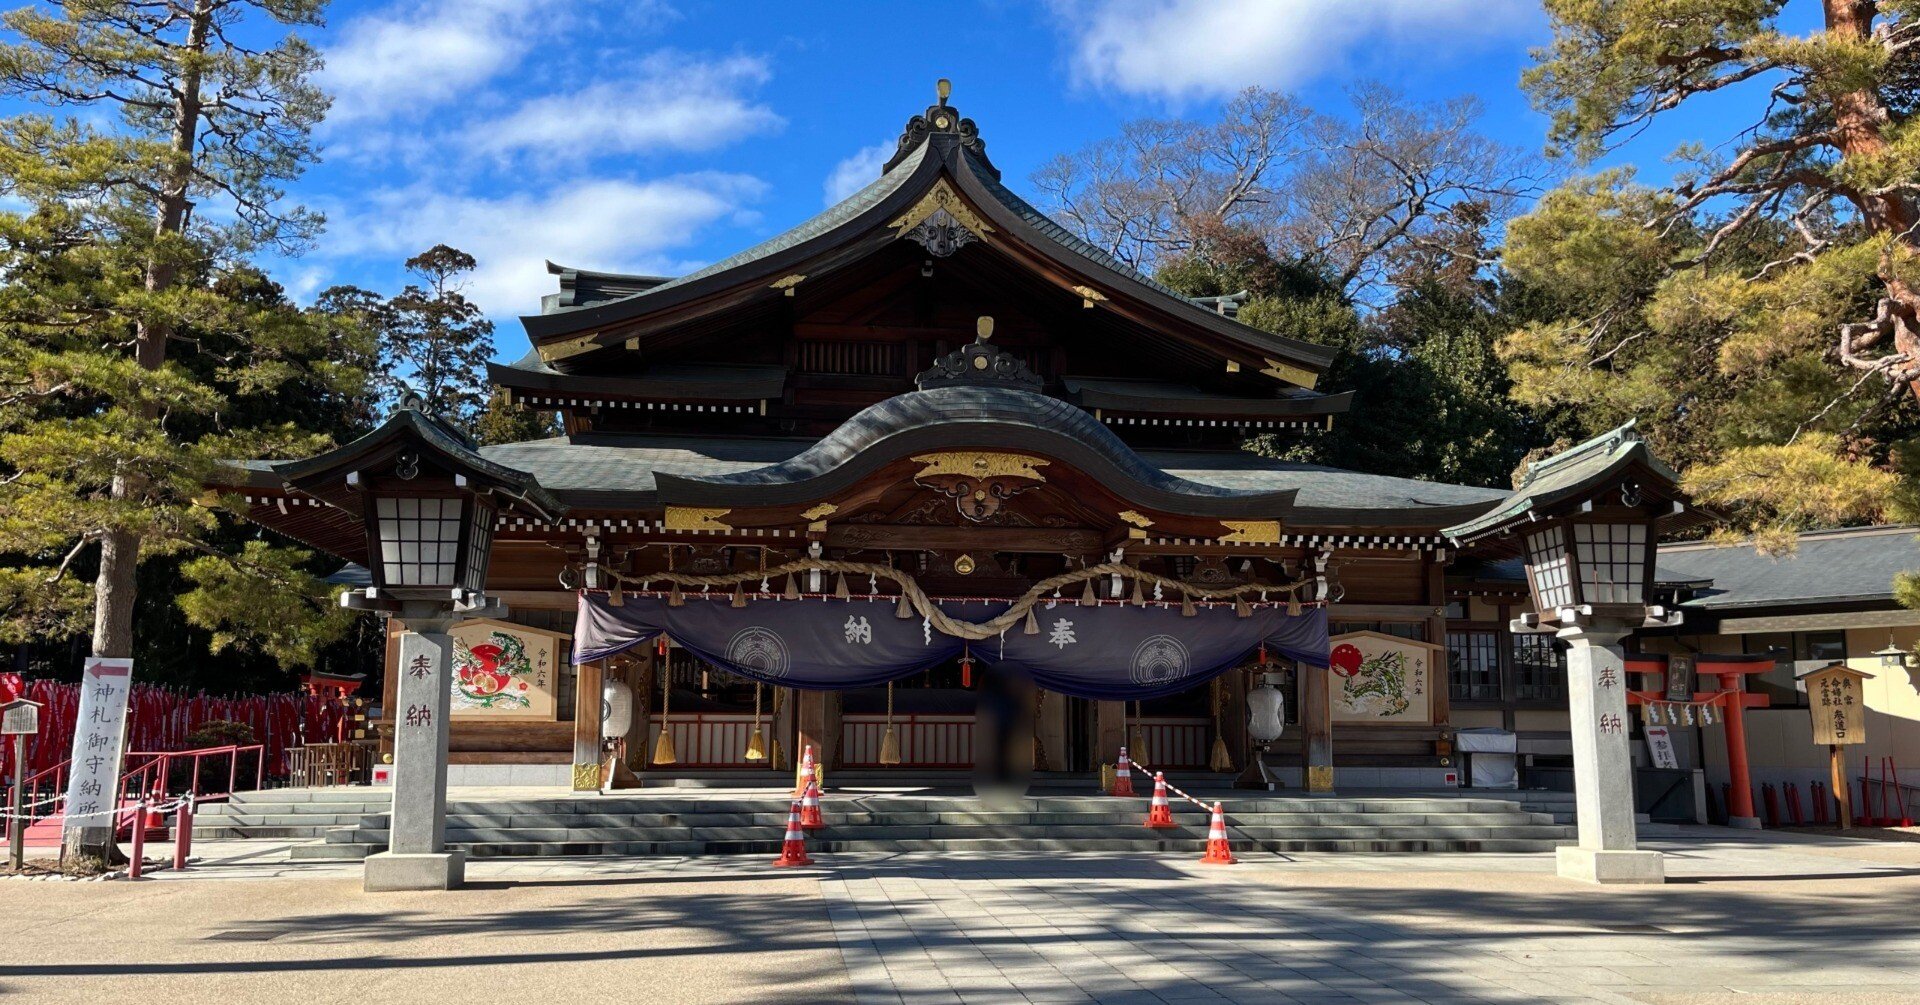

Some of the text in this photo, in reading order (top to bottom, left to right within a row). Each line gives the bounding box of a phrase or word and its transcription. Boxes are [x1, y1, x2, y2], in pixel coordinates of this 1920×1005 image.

[844, 615, 872, 645] 納
[1049, 617, 1077, 650] 奉
[536, 648, 548, 688] 令和六年
[406, 654, 432, 727] 奉納
[1598, 666, 1622, 734] 奉納
